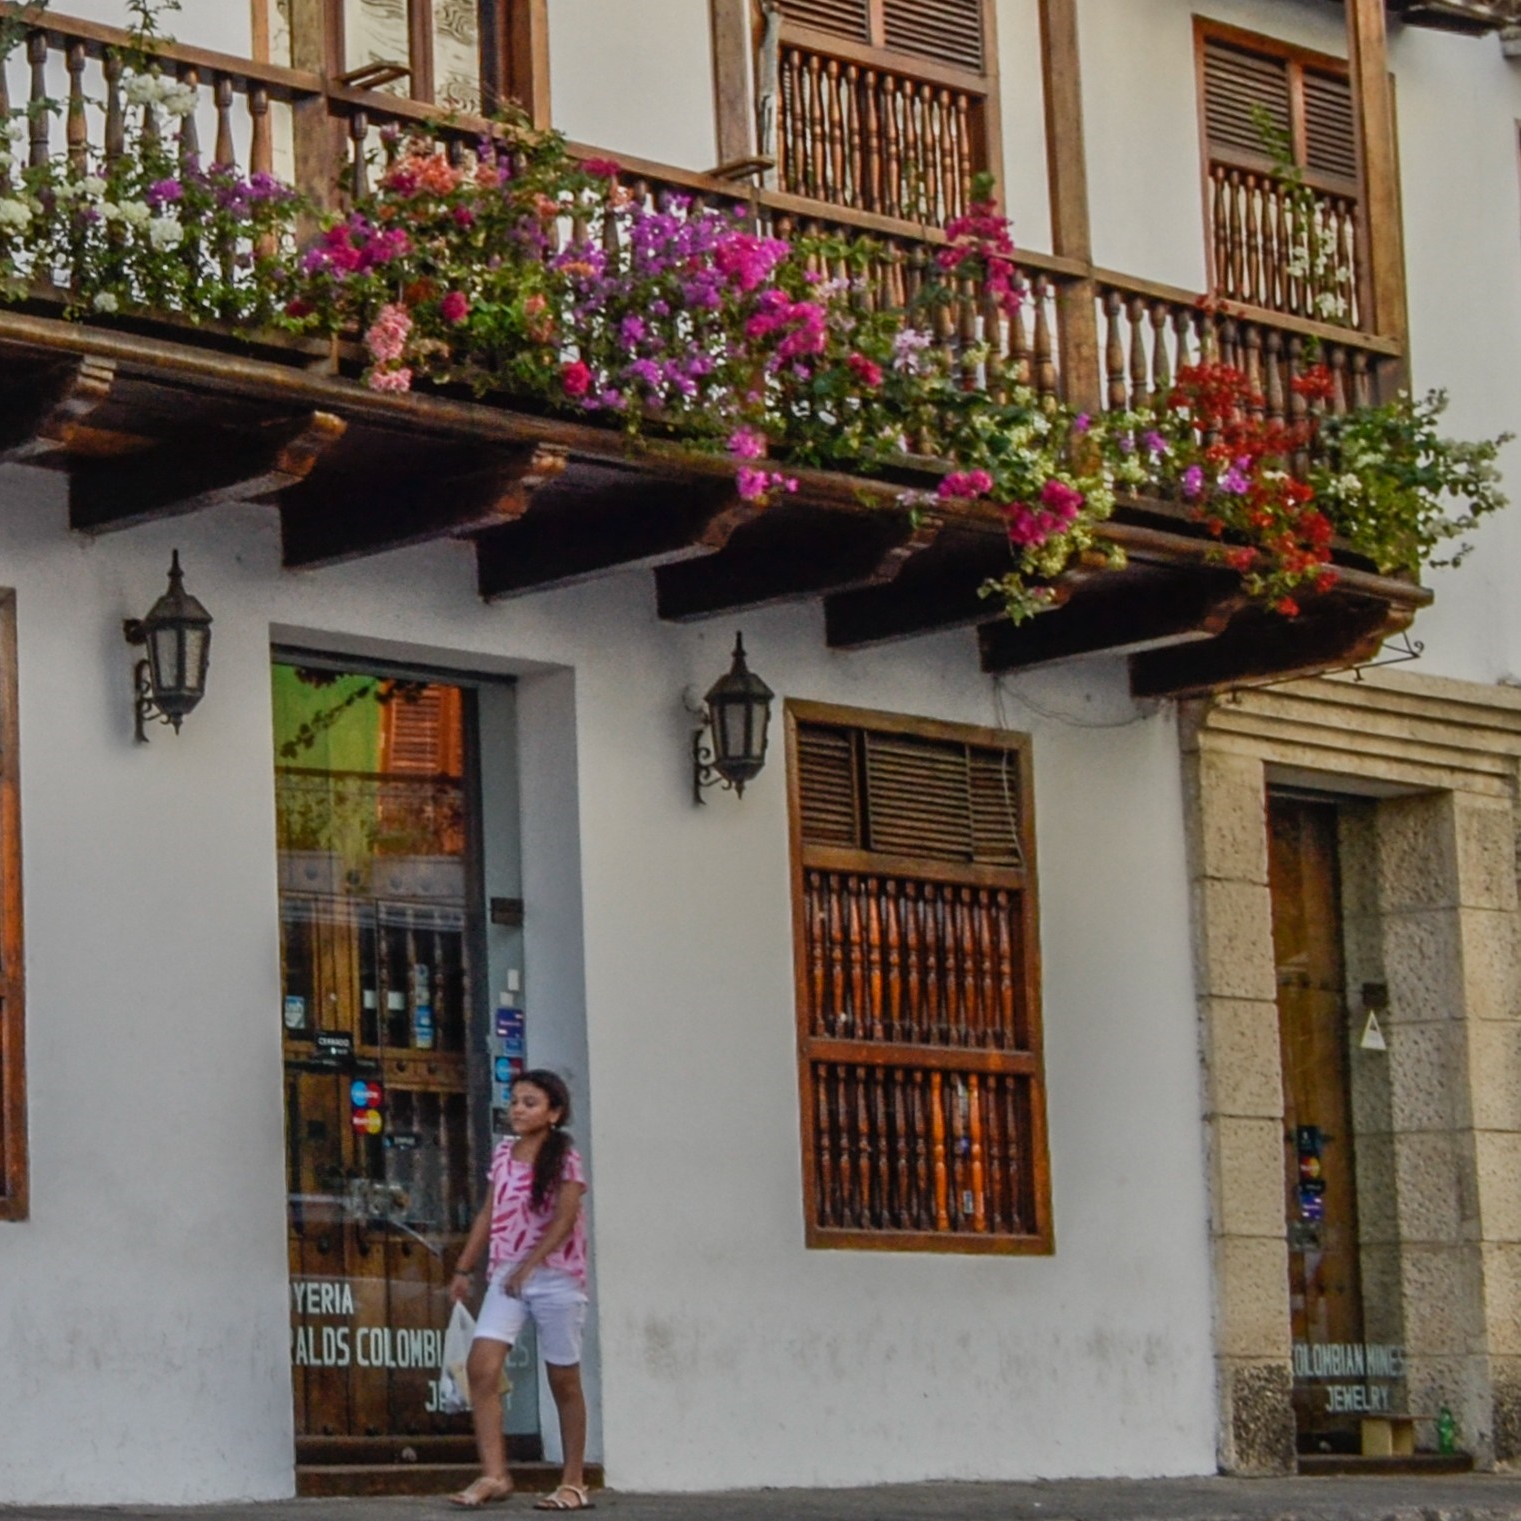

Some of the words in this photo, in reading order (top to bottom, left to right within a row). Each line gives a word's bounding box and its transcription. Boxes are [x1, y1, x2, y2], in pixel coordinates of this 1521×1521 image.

[290, 1282, 355, 1315] YERIA
[1292, 1342, 1365, 1377] OLOMBIAN
[1325, 1384, 1390, 1413] JEWELRY
